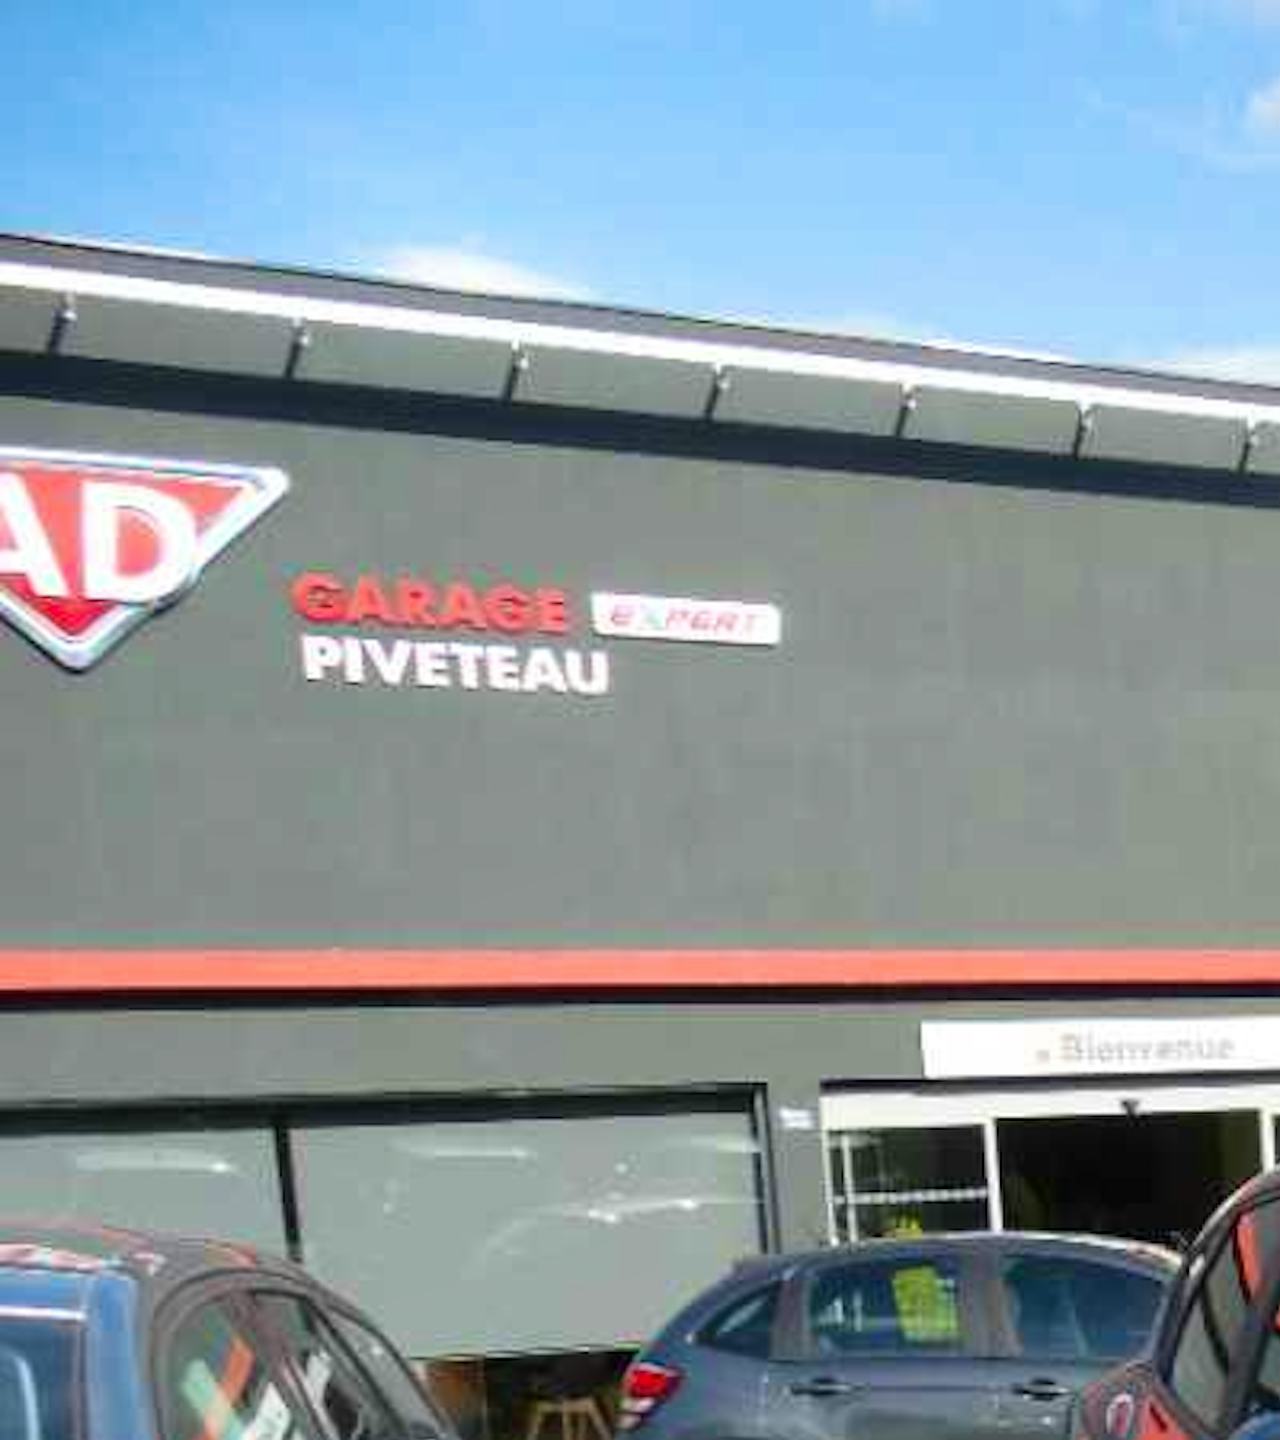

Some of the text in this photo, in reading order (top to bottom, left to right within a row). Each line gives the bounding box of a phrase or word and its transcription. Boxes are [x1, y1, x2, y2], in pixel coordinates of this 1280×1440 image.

[0, 471, 198, 602] AD
[292, 570, 568, 632] GARAGE
[300, 634, 610, 695] PIVETEAU
[1060, 1031, 1236, 1063] Bienvenue
